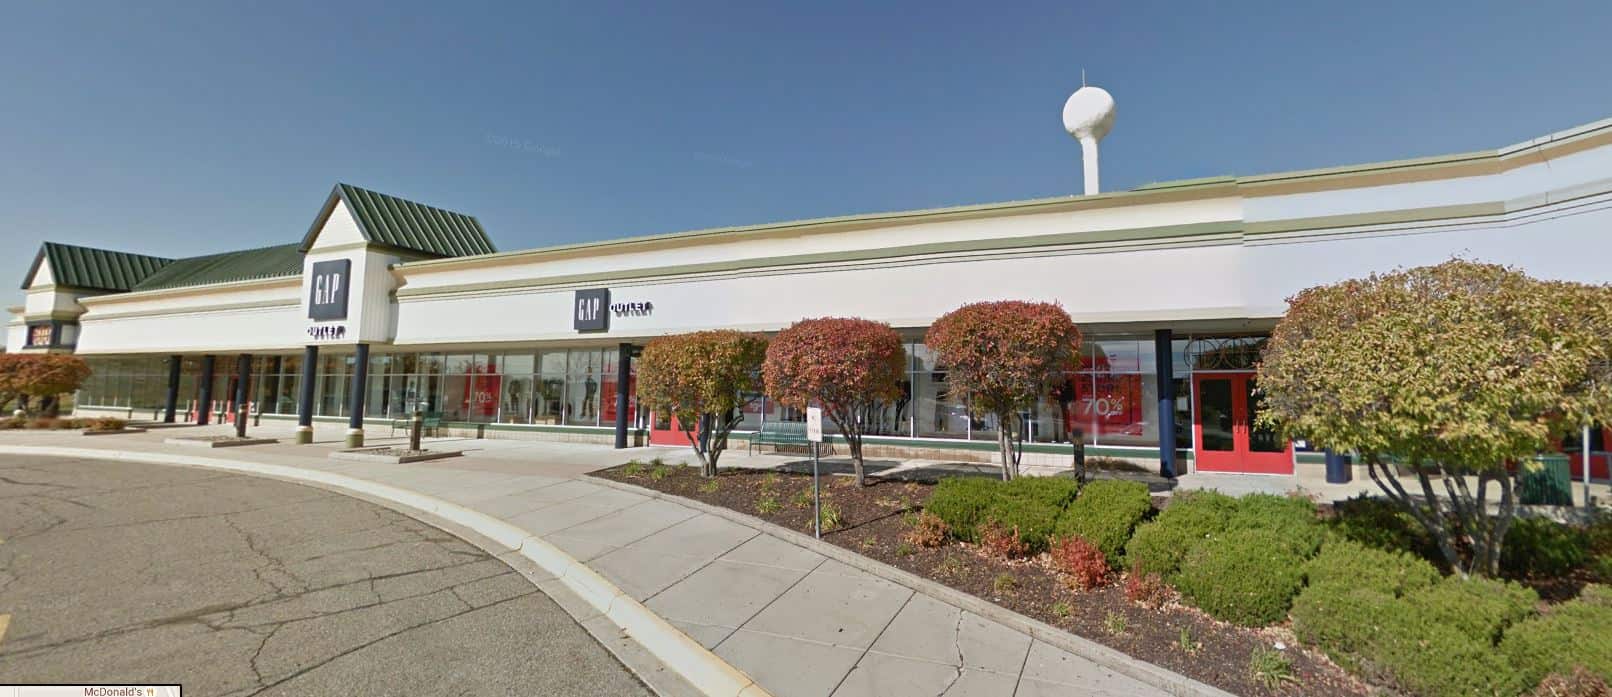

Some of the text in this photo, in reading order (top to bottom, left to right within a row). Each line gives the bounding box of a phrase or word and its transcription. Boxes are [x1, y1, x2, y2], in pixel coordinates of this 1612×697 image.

[315, 273, 340, 304] GAP
[578, 298, 652, 320] GAP OUTLET
[1081, 398, 1123, 416] 70%
